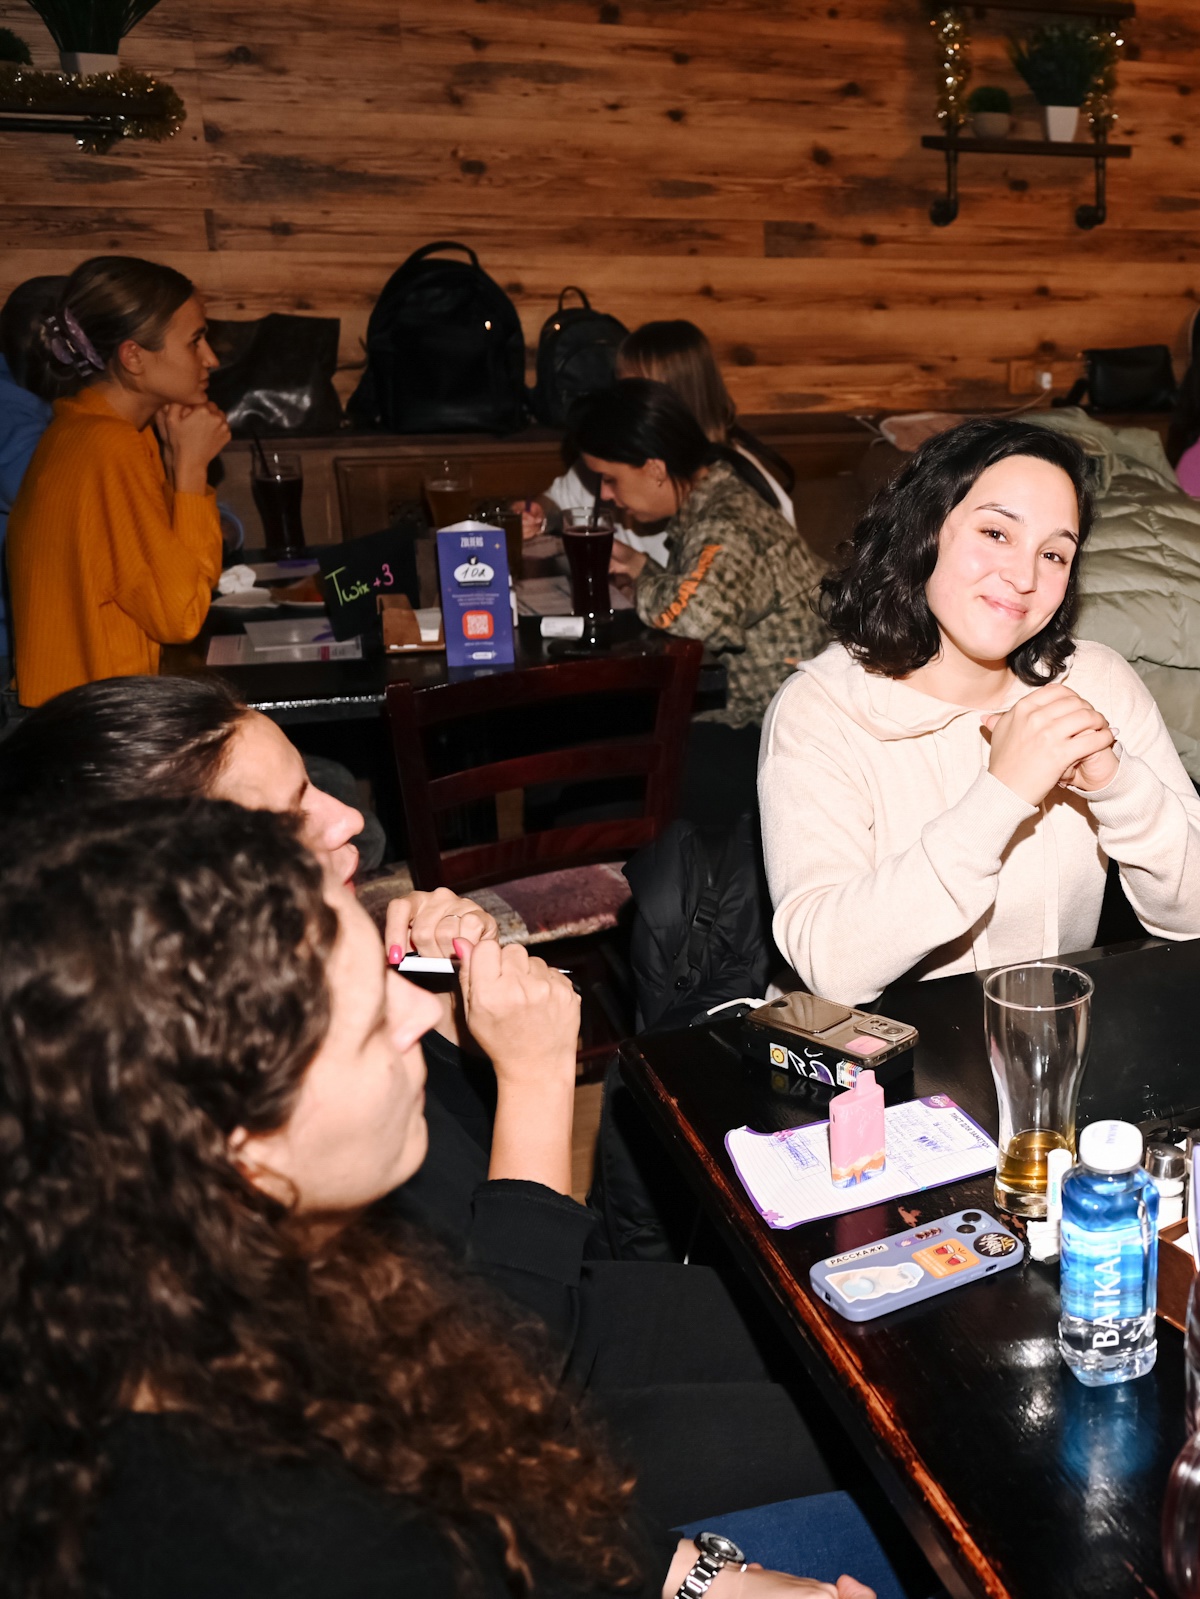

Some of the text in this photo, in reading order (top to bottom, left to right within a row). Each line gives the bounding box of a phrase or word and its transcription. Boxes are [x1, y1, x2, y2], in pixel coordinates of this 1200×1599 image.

[324, 566, 370, 606] Twix
[829, 1245, 885, 1266] РАССКАЖИ
[1092, 1240, 1121, 1349] BAIKAL
